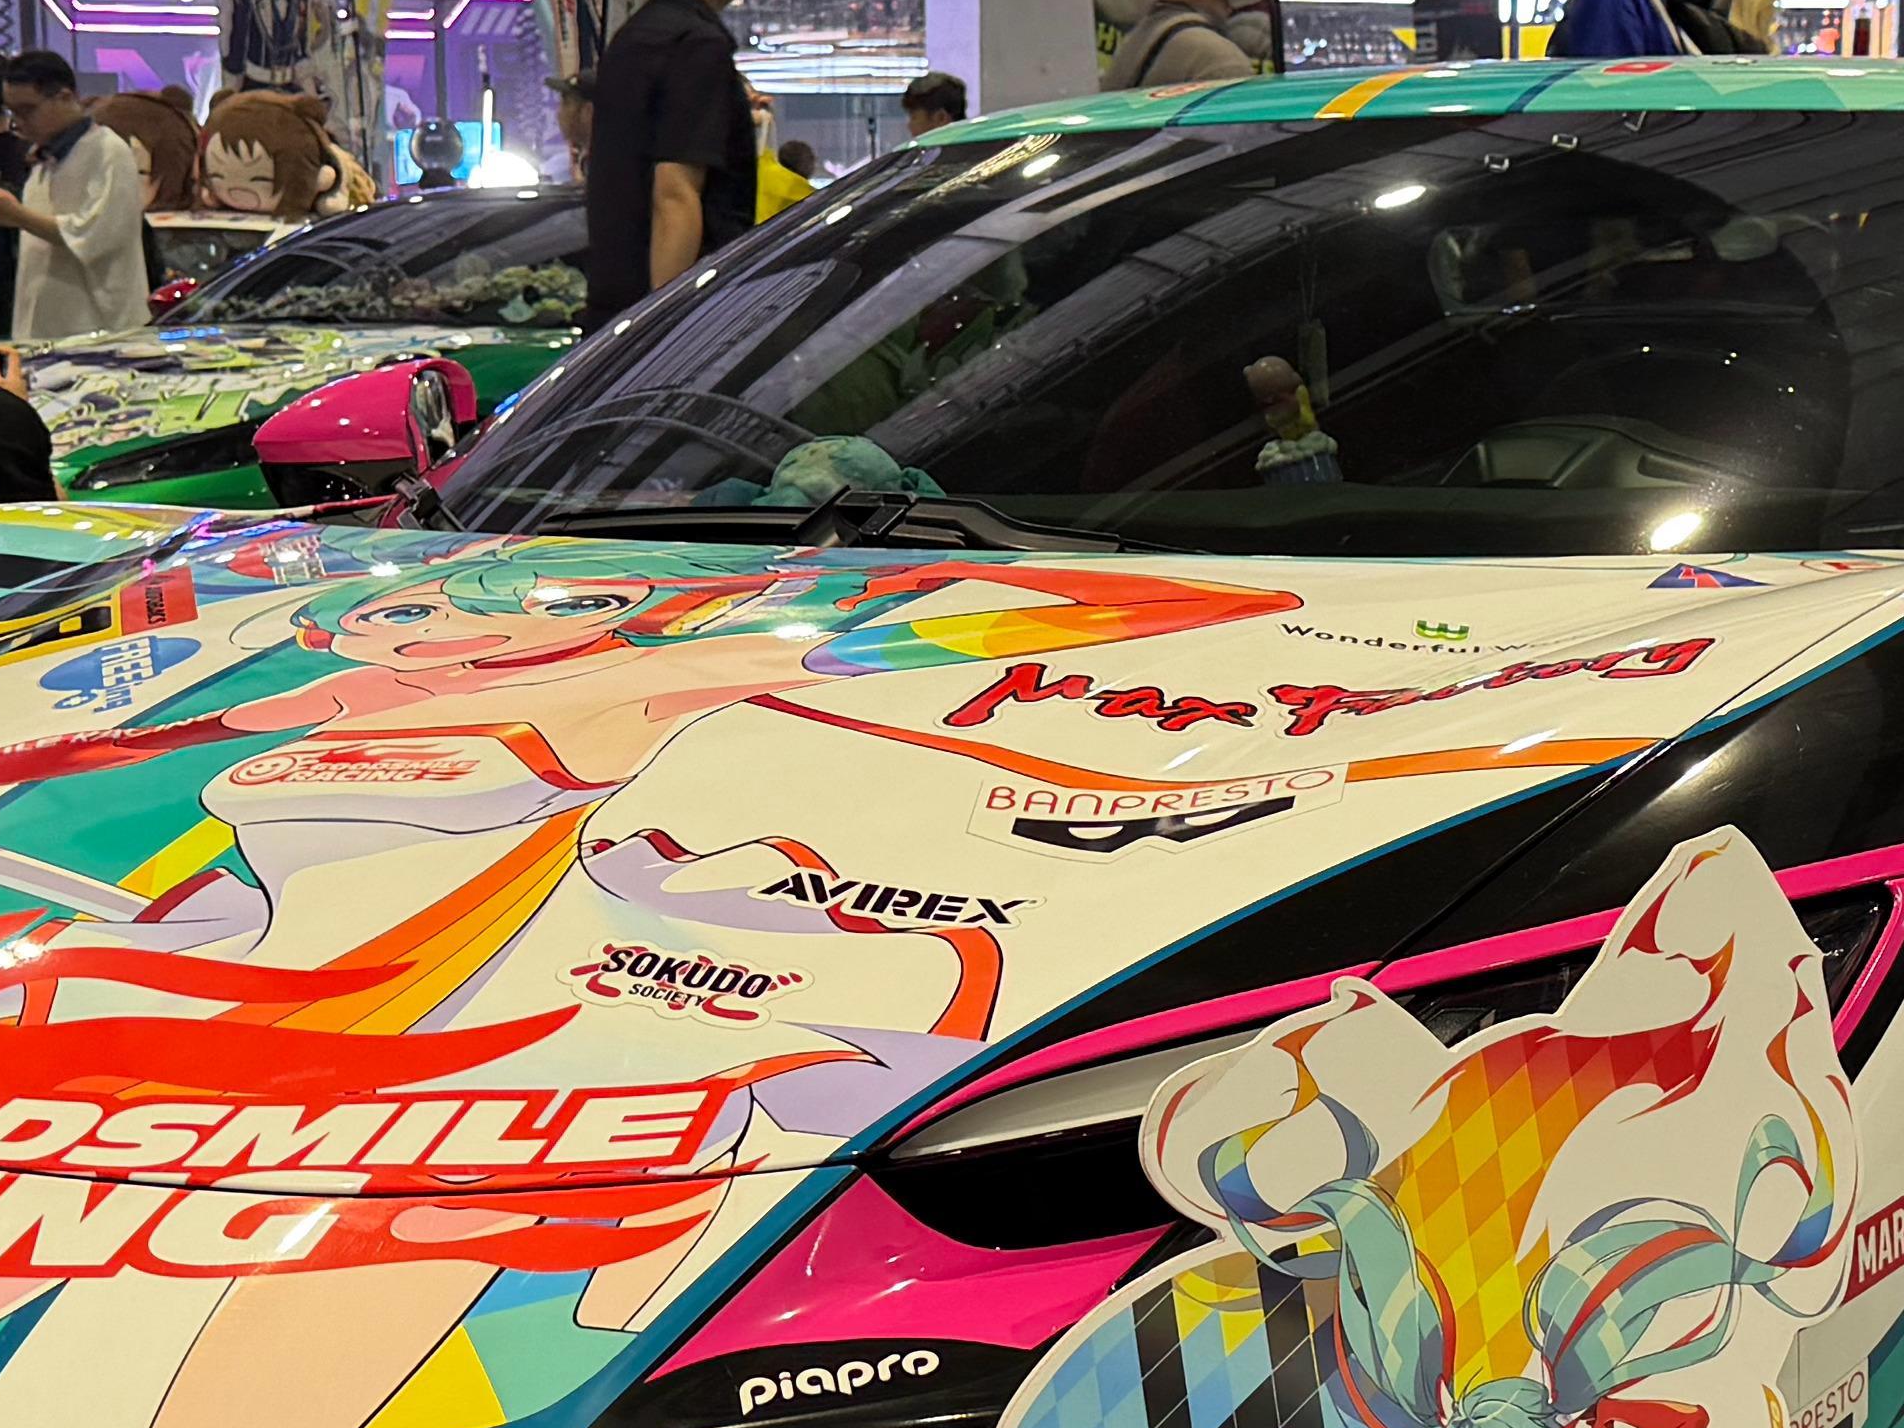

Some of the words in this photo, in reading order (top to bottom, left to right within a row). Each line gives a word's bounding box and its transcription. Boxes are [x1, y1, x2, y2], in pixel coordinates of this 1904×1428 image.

[1280, 622, 1481, 654] Wonderful
[942, 662, 1259, 732] Max
[287, 770, 423, 782] RACING
[985, 768, 1334, 815] BANPRESTO
[759, 871, 1033, 925] AVIREX
[600, 948, 774, 1000] SOKUDO
[628, 981, 708, 1008] SOCIETY
[738, 1347, 941, 1416] piapro
